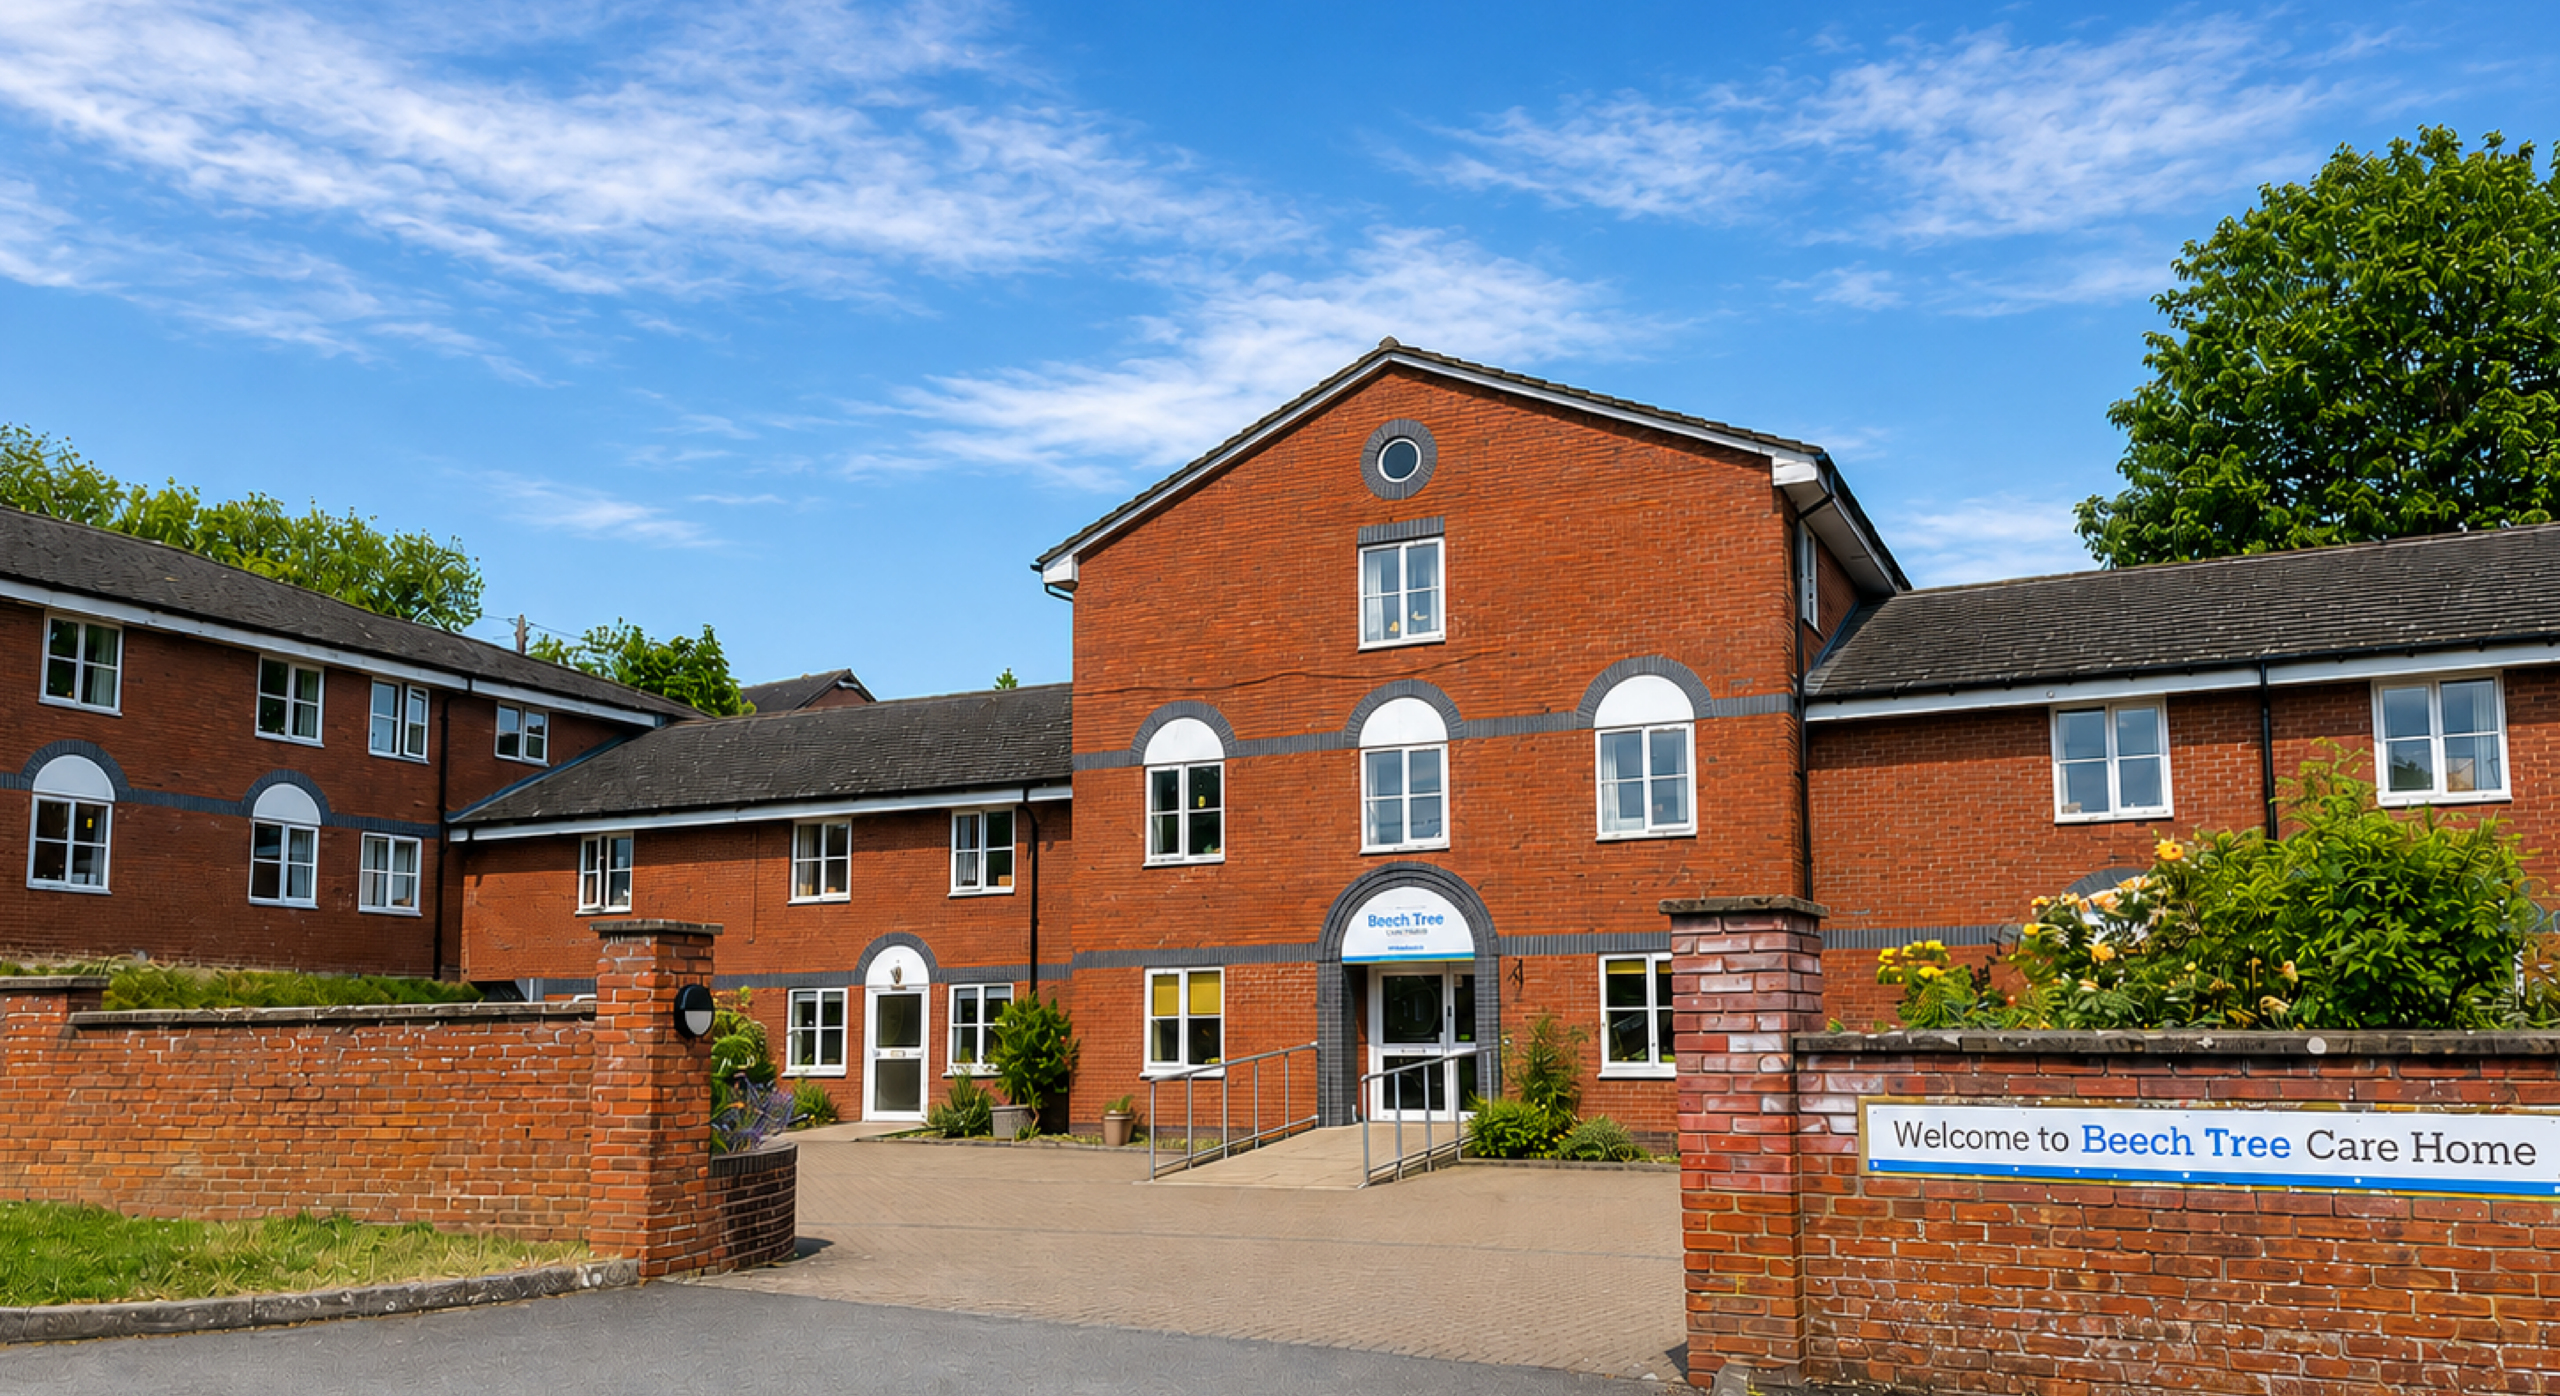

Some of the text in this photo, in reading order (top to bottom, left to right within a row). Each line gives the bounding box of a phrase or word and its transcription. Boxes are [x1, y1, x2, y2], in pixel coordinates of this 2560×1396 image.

[1367, 912, 1444, 928] Beech Tree
[1893, 1120, 2537, 1166] Welcome to Beech Tree Care Home
